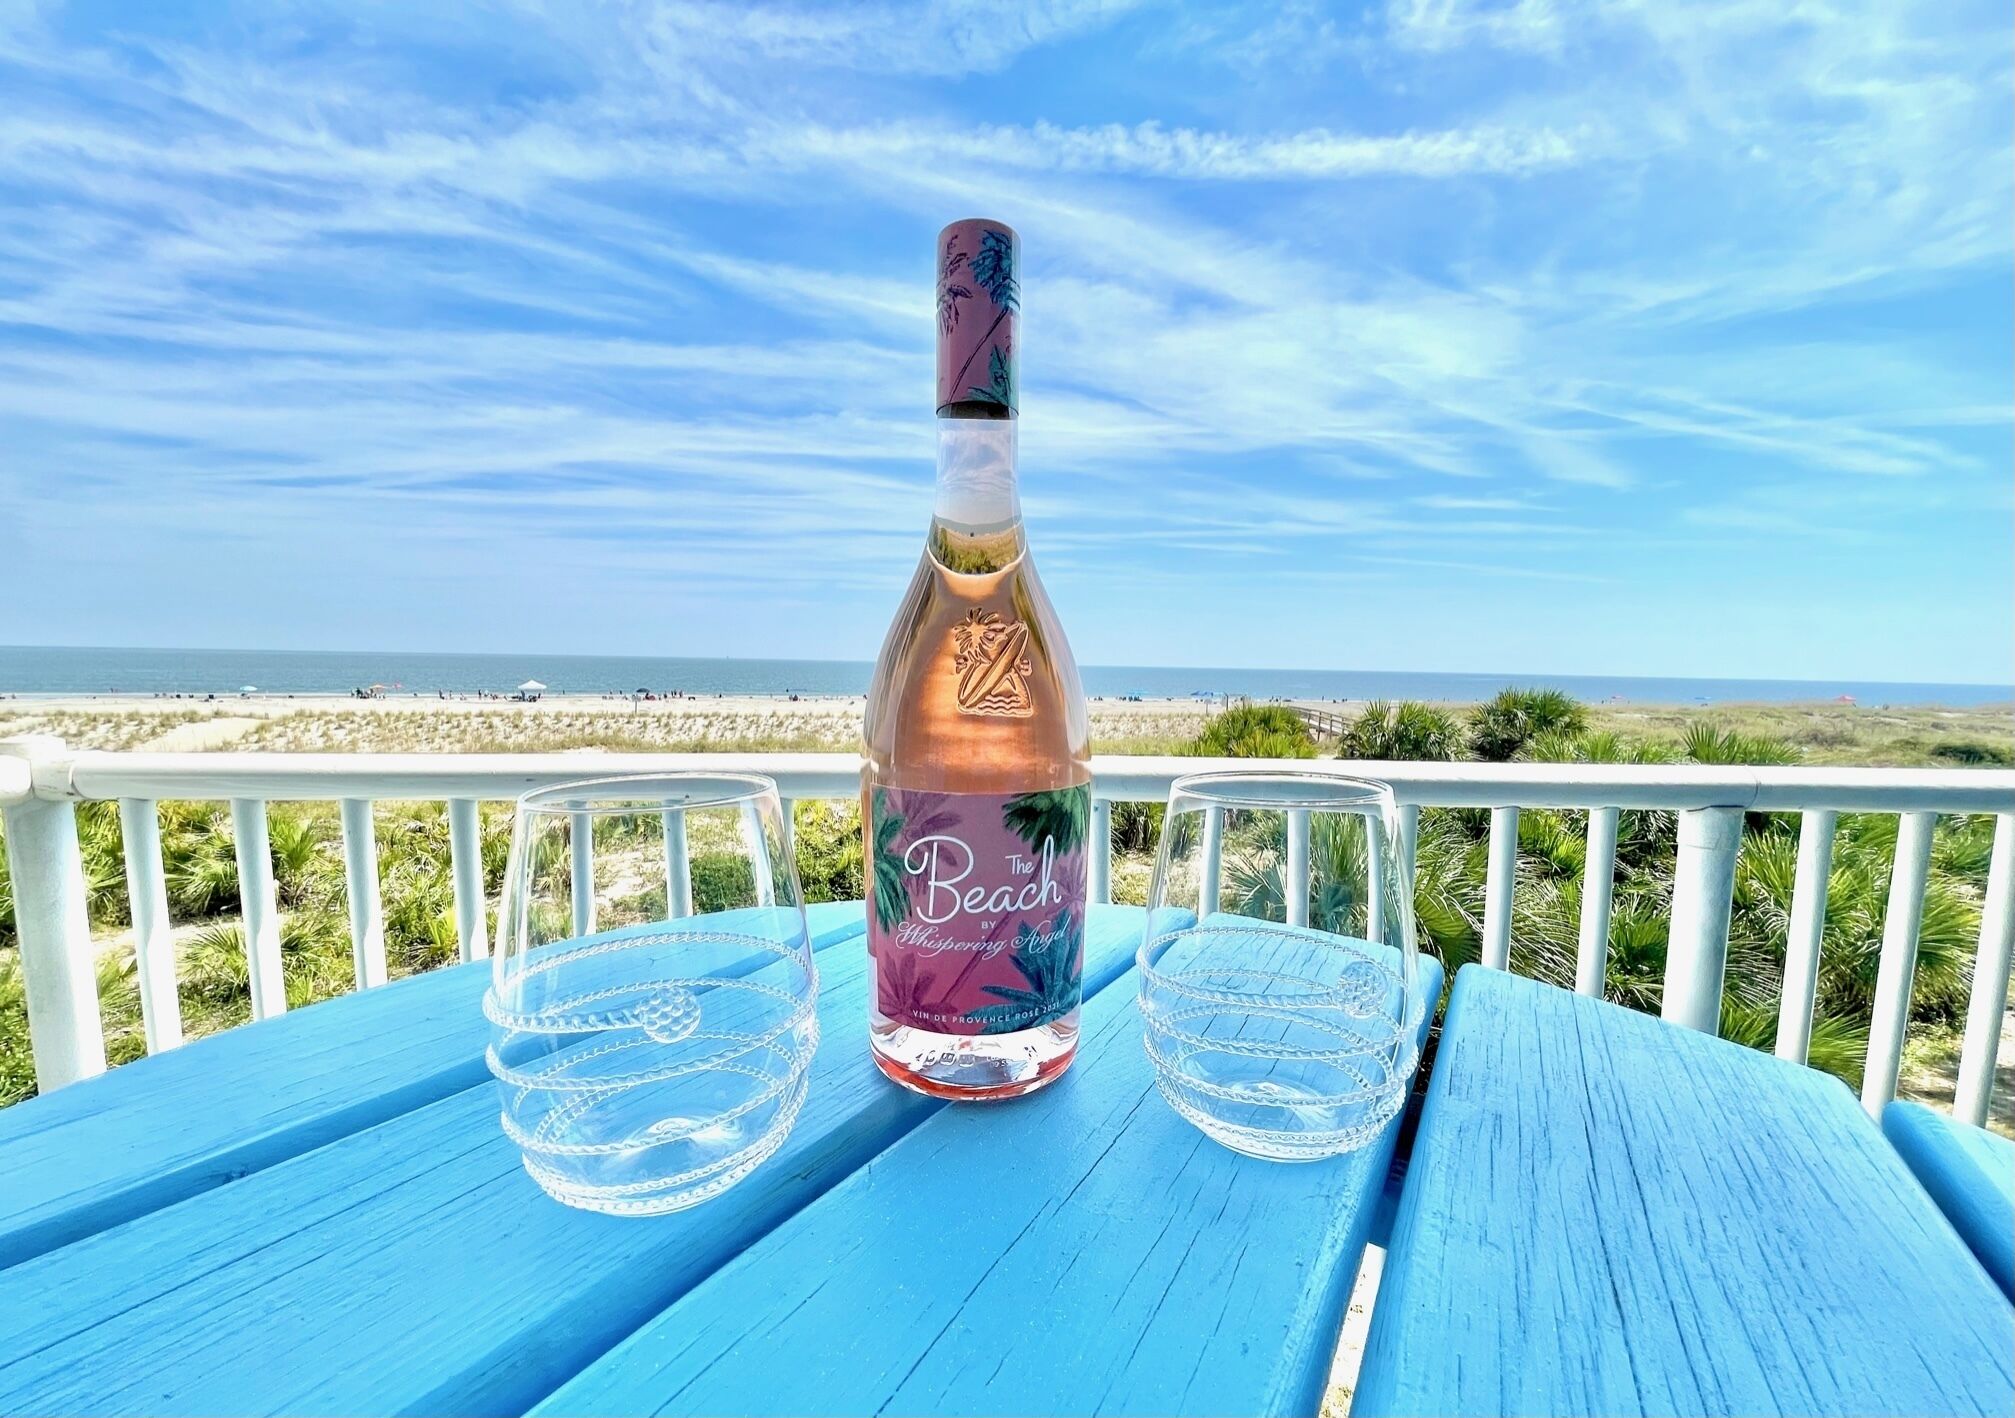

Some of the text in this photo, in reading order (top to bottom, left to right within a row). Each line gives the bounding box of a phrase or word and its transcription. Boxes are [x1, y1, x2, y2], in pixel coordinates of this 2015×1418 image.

[1005, 854, 1034, 875] The
[904, 834, 1062, 924] Beach
[981, 920, 996, 931] BY
[895, 914, 1071, 960] Whispering Angel
[912, 1009, 929, 1020] VIN
[934, 1014, 947, 1022] DE
[952, 1013, 1010, 1024] PROVENCE
[1015, 1007, 1039, 1020] ROSÉ
